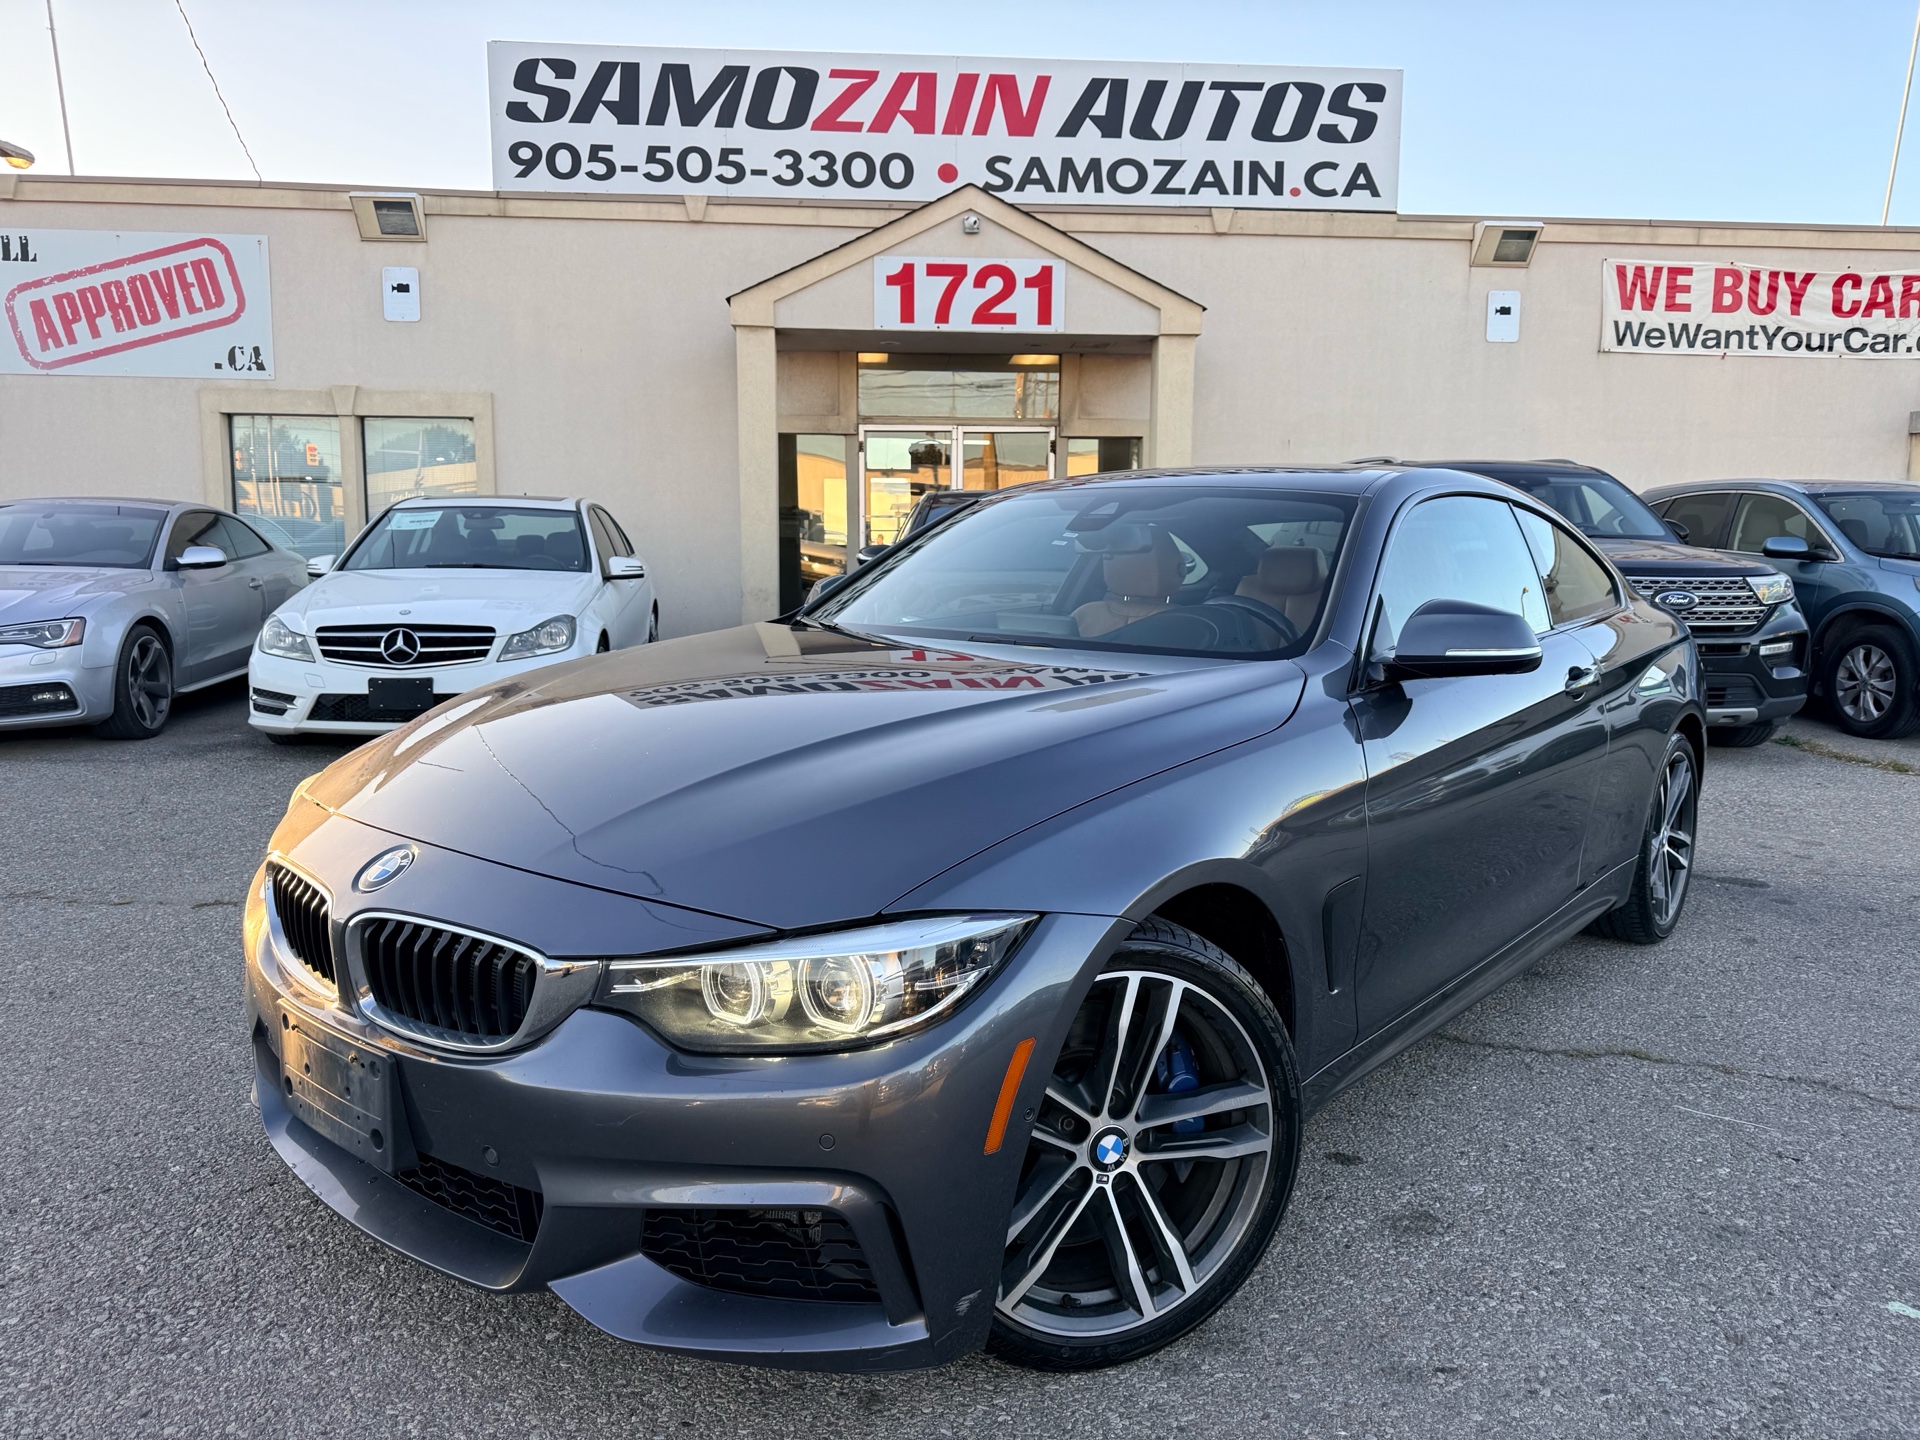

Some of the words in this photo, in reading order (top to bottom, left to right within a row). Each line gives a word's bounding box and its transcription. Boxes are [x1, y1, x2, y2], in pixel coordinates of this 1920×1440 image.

[505, 57, 1052, 138] SAMOZAIN
[1055, 77, 1387, 144] AUTOS
[508, 140, 914, 190] 905-505-3300
[982, 154, 1382, 198] SAMOZAIN.CA
[29, 257, 226, 353] APPROVED
[886, 262, 1053, 326] 1721
[1615, 265, 1694, 312] WE
[1712, 268, 1817, 317] BUY
[1831, 272, 1920, 319] CAR
[1613, 319, 1920, 354] WeWantYourCar.
[1665, 594, 1690, 605] Ford
[1107, 1138, 1130, 1172] BMW
